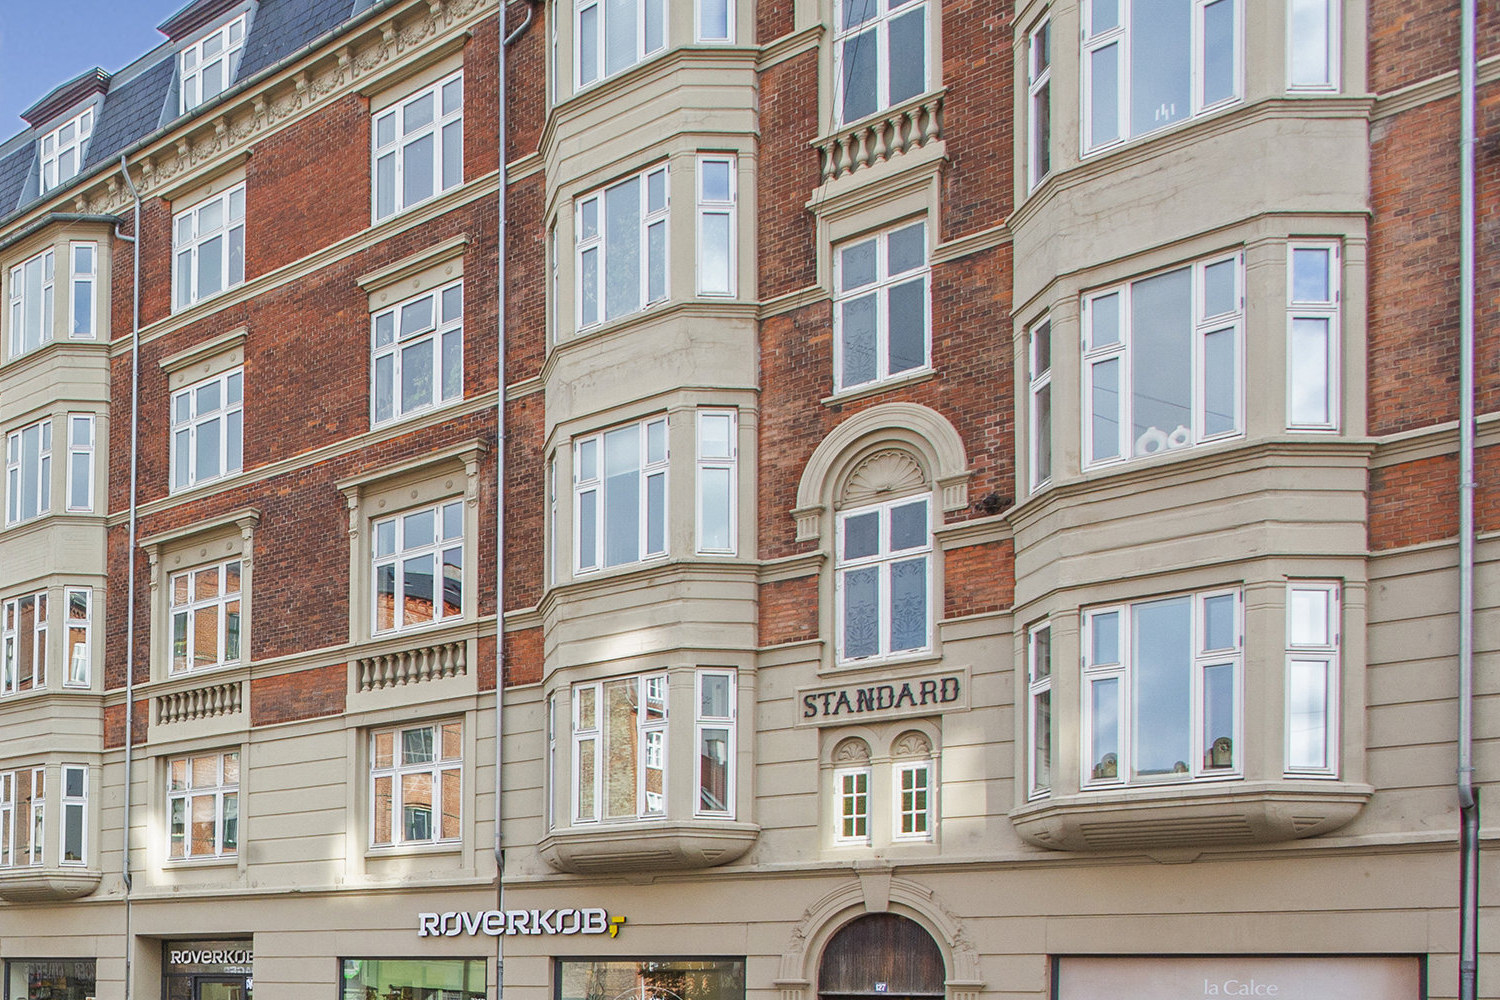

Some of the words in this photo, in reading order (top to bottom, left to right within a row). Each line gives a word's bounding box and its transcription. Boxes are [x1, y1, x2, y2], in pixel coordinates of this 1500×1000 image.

[803, 677, 960, 718] STANDARD
[1204, 979, 1219, 995] la
[1223, 979, 1278, 996] Calce
